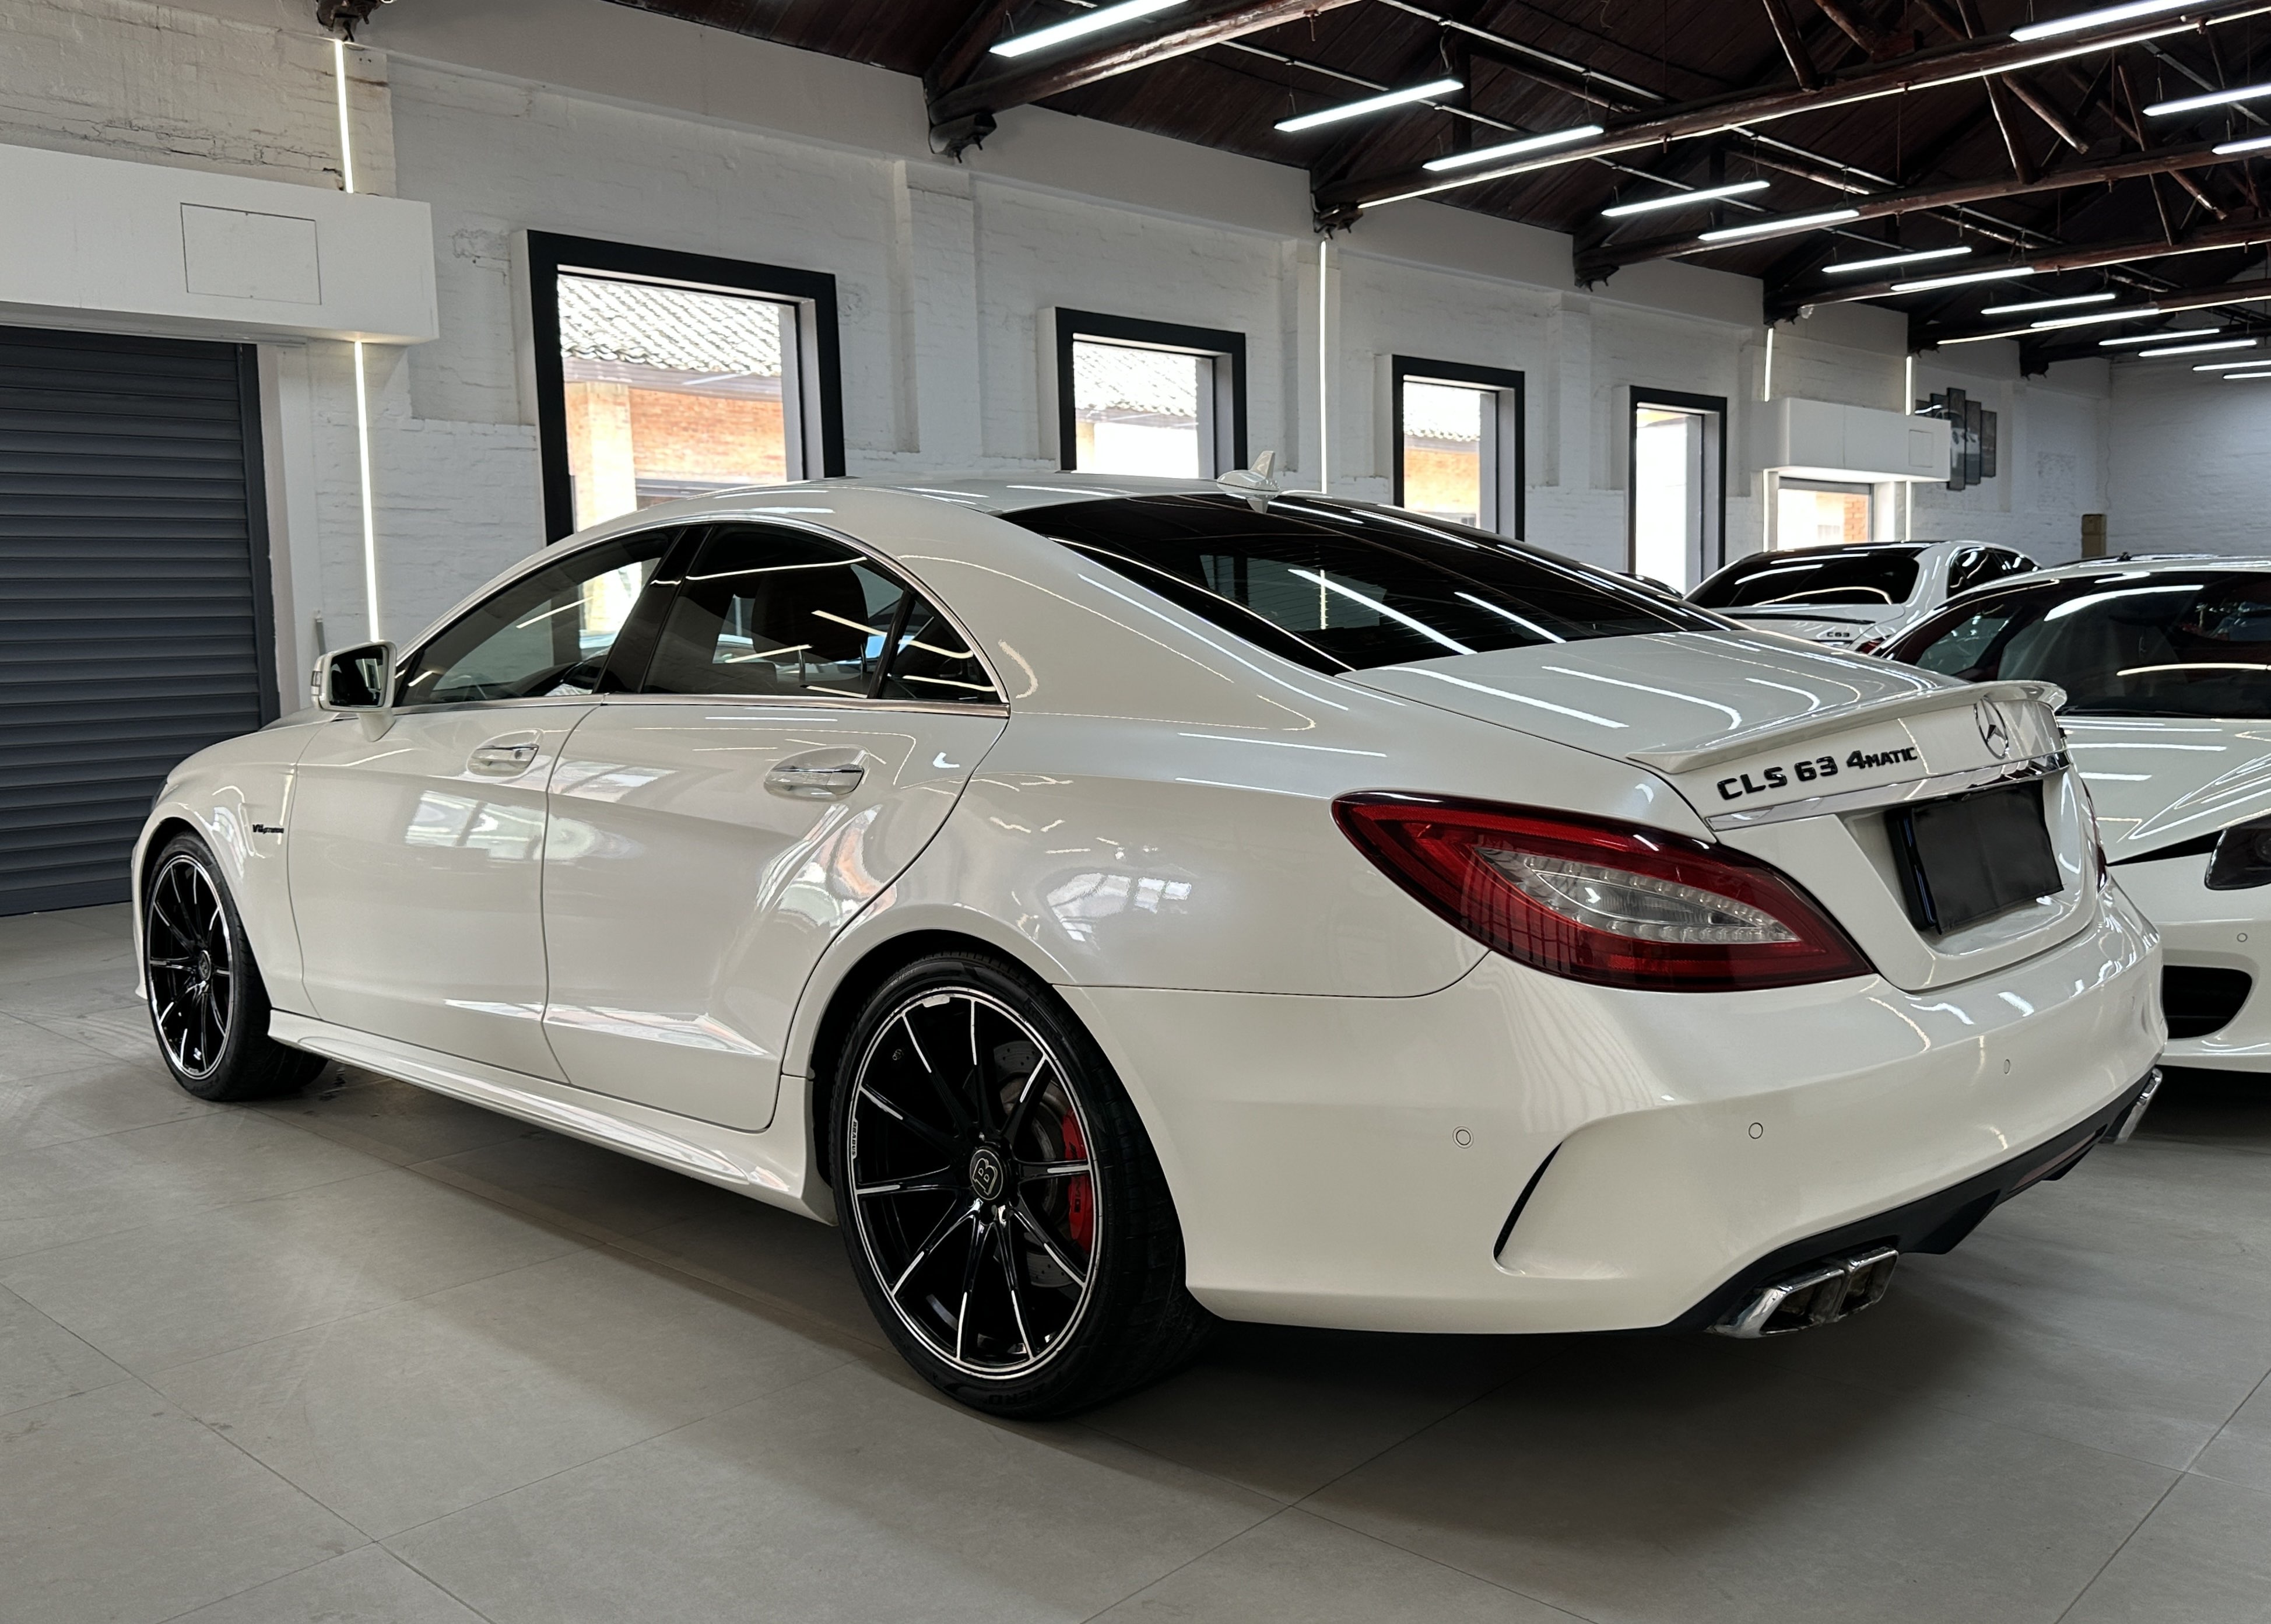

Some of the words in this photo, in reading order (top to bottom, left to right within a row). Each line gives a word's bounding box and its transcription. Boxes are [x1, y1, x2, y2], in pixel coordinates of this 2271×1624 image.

[1717, 766, 1788, 801] CLS
[1794, 756, 1838, 782] 63
[1846, 747, 1918, 769] 4MATIC
